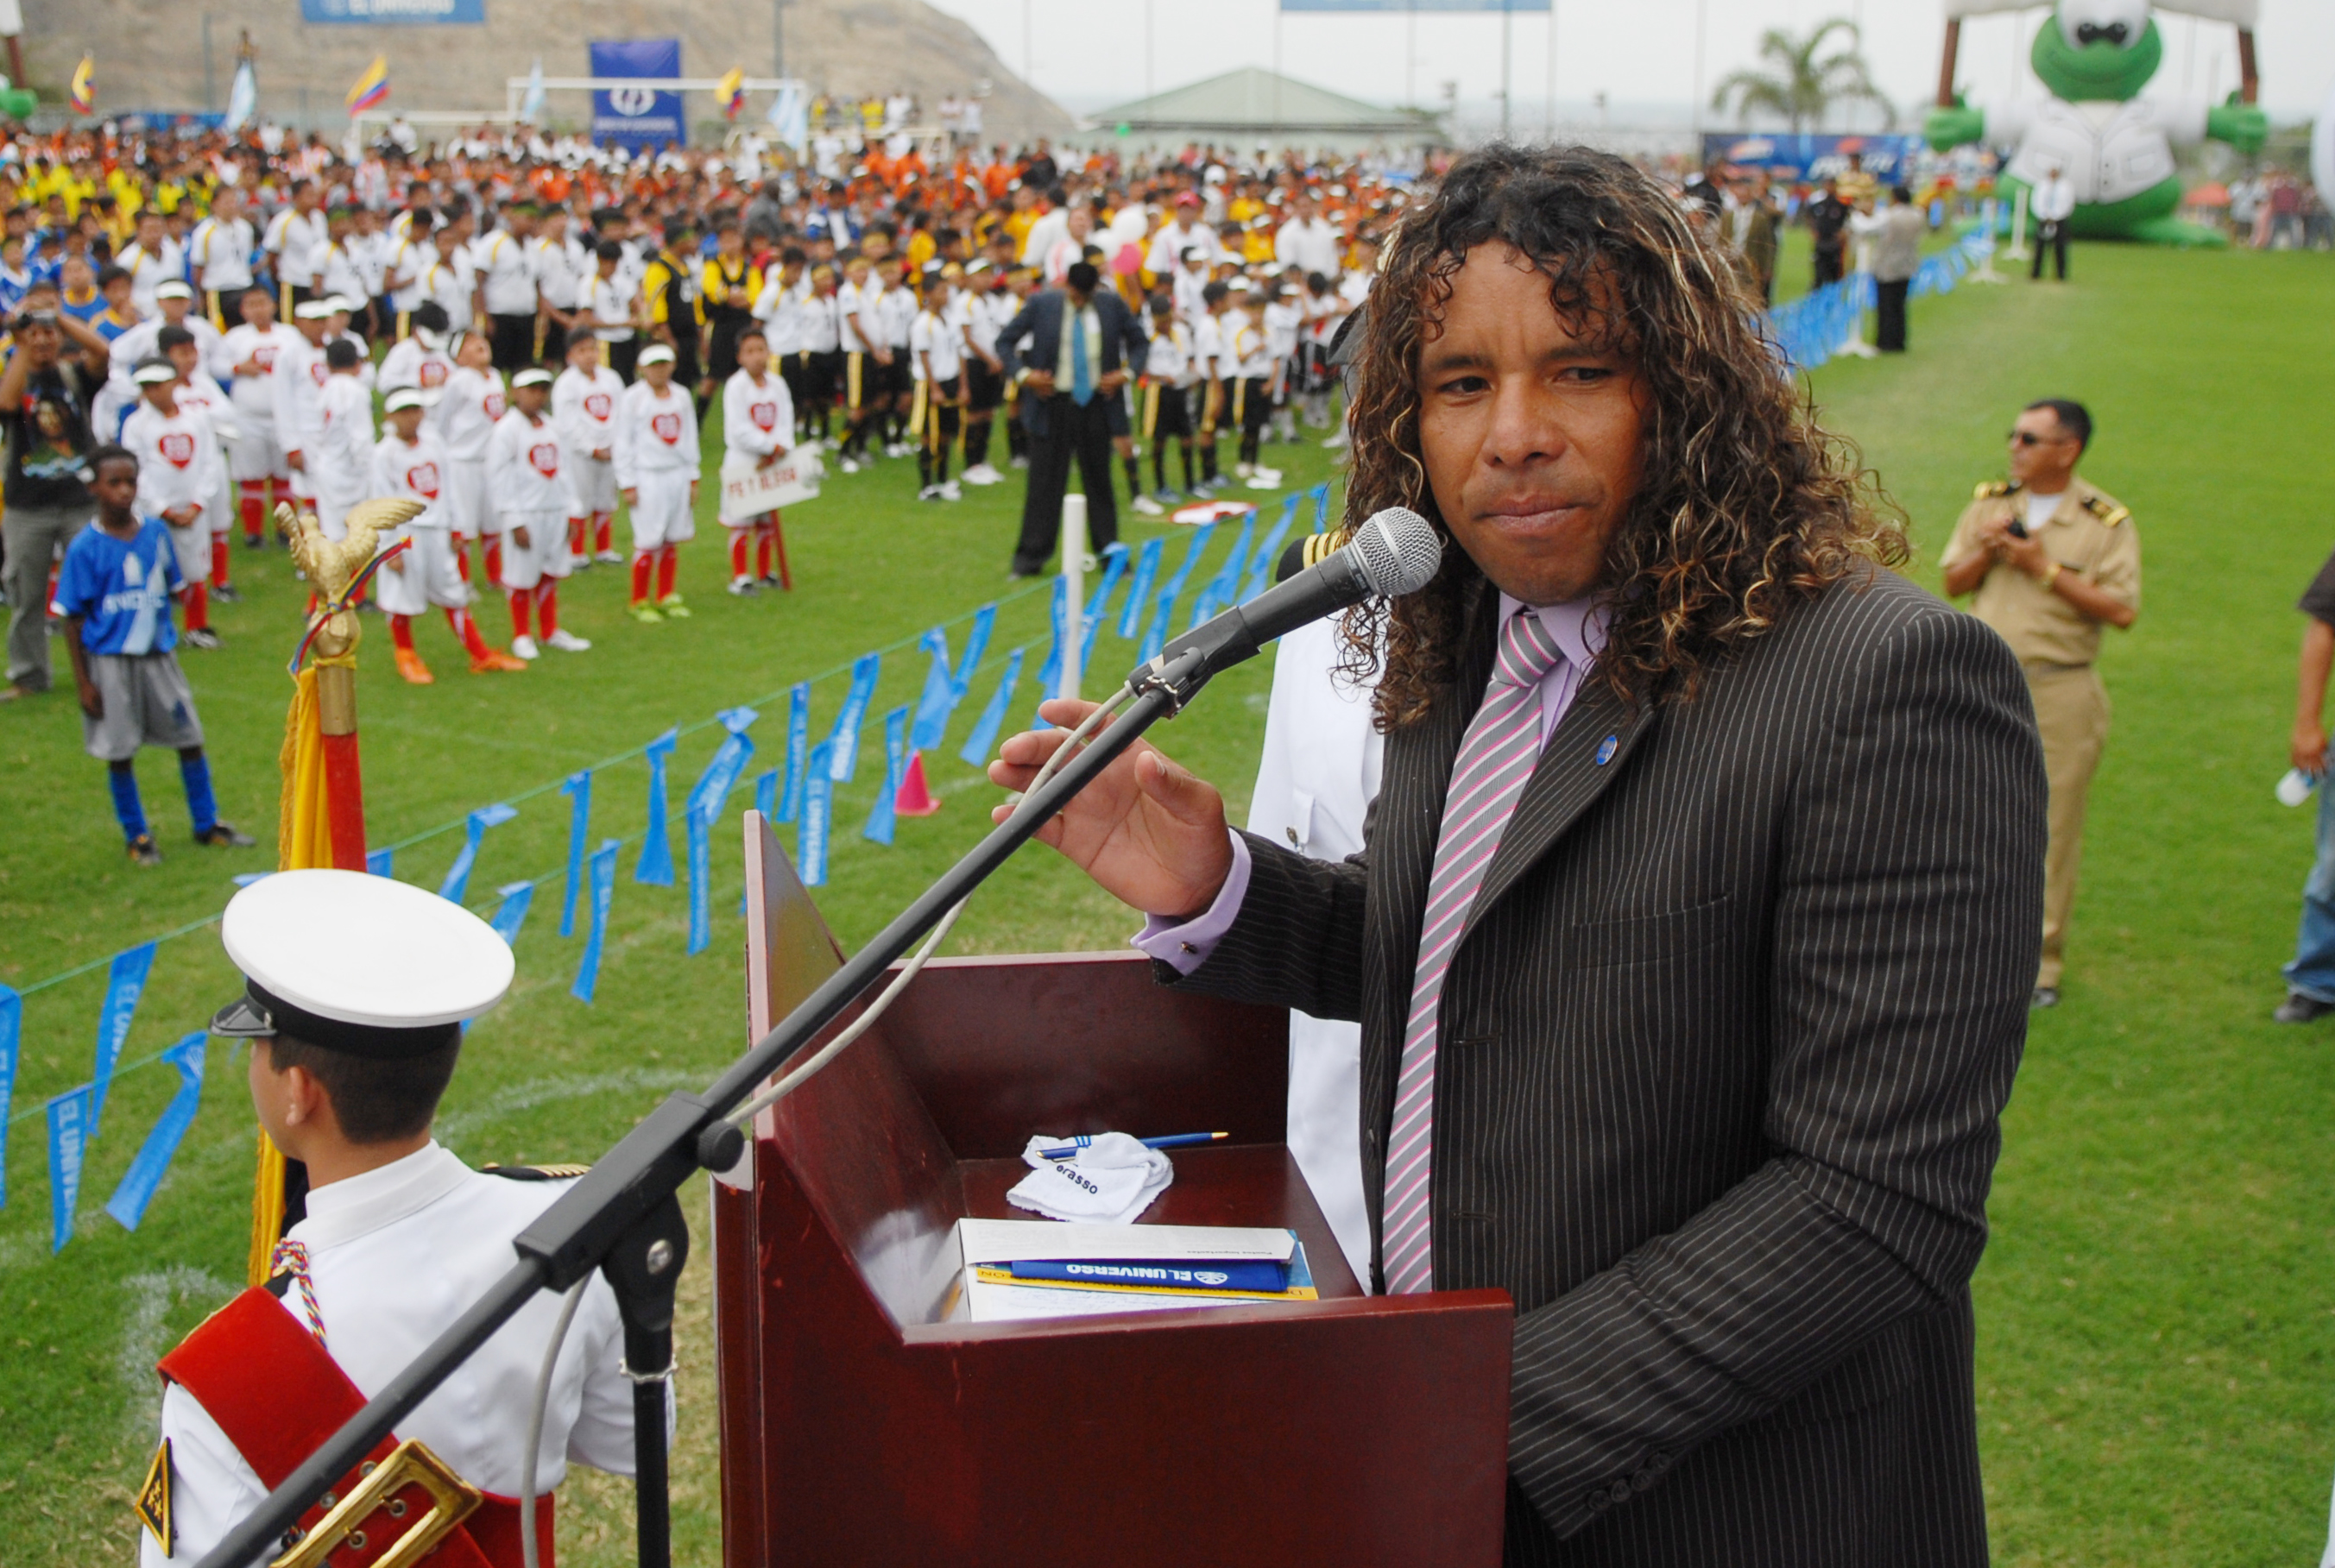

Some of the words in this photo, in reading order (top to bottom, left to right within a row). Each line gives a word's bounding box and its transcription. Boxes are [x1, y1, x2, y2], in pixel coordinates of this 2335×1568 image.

[58, 1099, 79, 1127] EL
[1066, 1263, 1167, 1280] UNIVERSO
[1168, 1269, 1192, 1281] EL
